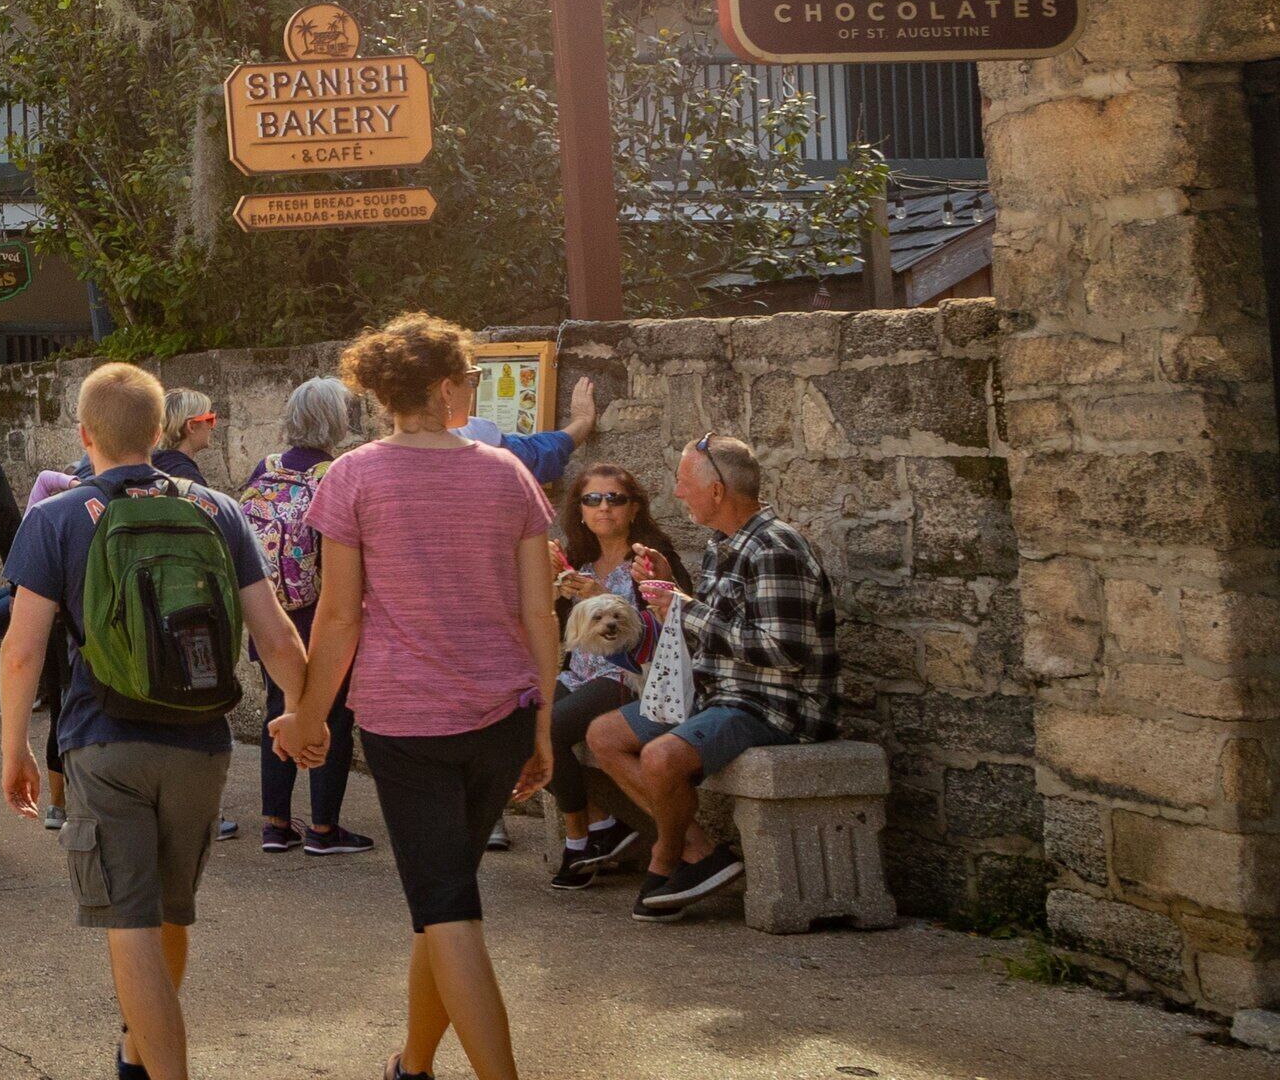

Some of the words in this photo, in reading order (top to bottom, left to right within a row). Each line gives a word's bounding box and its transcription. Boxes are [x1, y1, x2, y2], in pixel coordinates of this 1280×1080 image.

[838, 28, 860, 40] OF
[867, 27, 890, 40] ST.
[896, 25, 991, 39] AUGUSTINE
[245, 64, 408, 100] SPANISH
[256, 104, 400, 138] BAKERY
[268, 199, 308, 211] FRESH
[313, 197, 353, 209] BREAD
[363, 194, 407, 206] SOUPS
[250, 212, 329, 225] EMPANADAS
[336, 208, 379, 220] BAKED
[383, 206, 428, 218] GOODS
